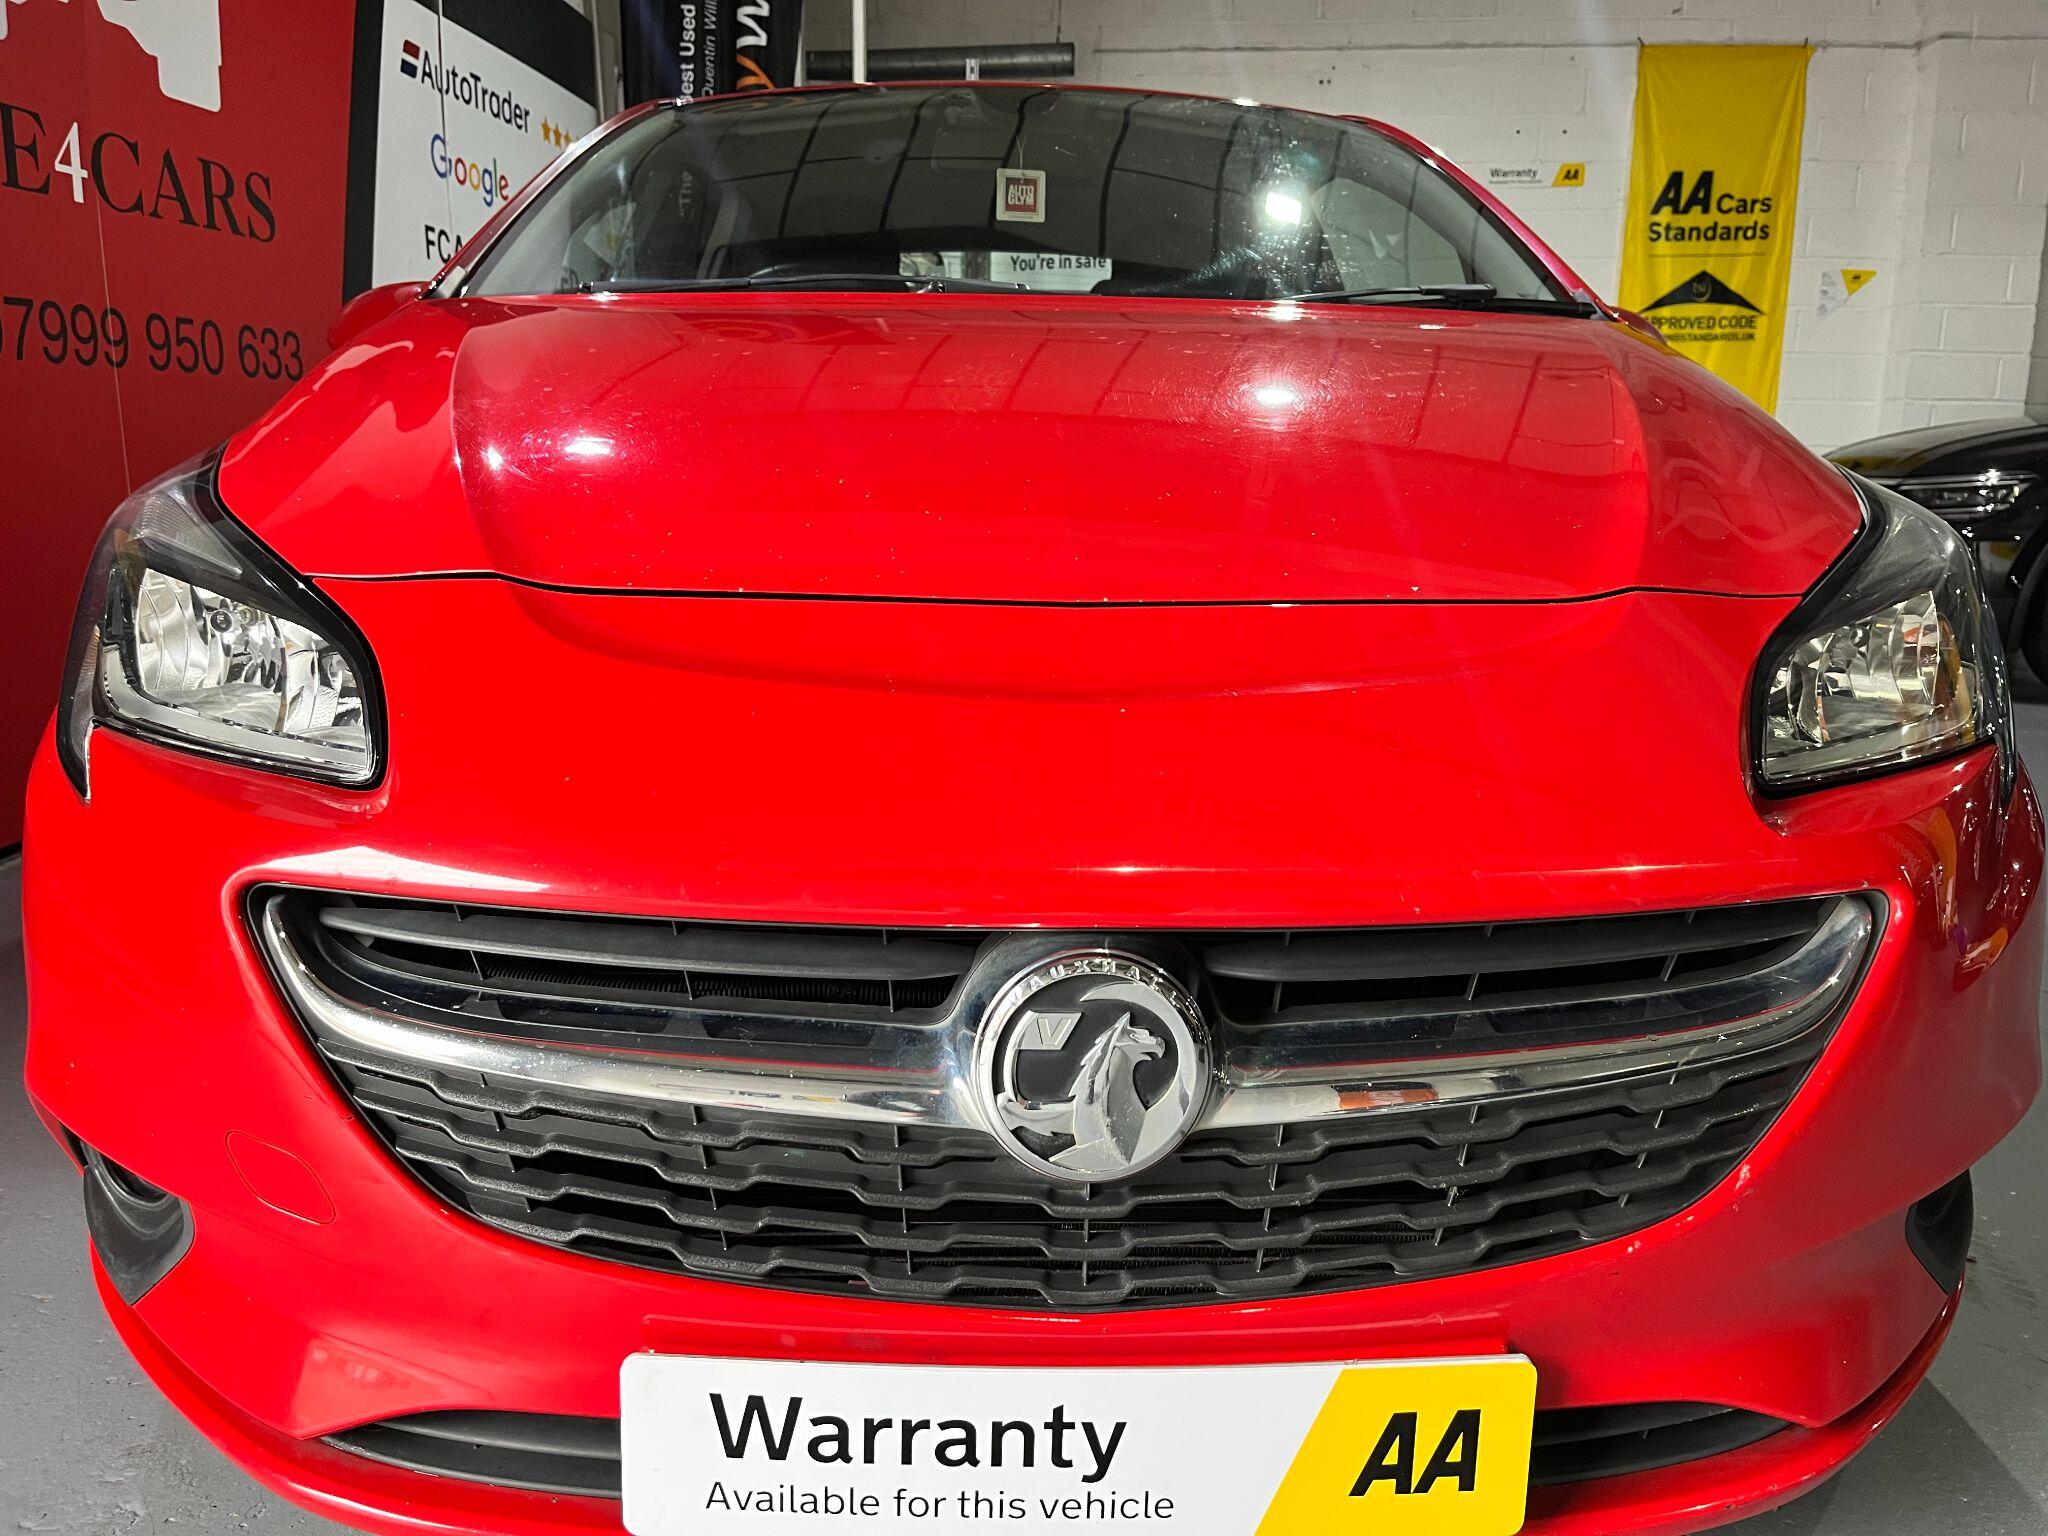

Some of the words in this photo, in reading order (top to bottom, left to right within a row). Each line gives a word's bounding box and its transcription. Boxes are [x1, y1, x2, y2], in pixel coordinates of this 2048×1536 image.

[679, 4, 696, 56] Used
[421, 50, 530, 133] AutoTrader
[431, 133, 509, 207] Google
[1009, 184, 1034, 195] AUTO
[1489, 168, 1539, 179] Warranty
[1562, 168, 1580, 180] AA
[1650, 170, 1714, 215] AA
[1716, 193, 1773, 215] Cars
[1648, 220, 1770, 242] Standards
[1010, 254, 1055, 271] You're
[1060, 254, 1072, 269] in
[0, 295, 129, 369] 7999
[146, 312, 225, 376] 950
[238, 323, 304, 382] 633
[1718, 314, 1758, 330] CODE
[708, 1392, 1127, 1484] Warranty
[1348, 1408, 1482, 1497] AA
[705, 1481, 880, 1517] Available
[893, 1488, 947, 1518] for
[957, 1489, 1027, 1520] this
[1039, 1490, 1175, 1520] vehicle
